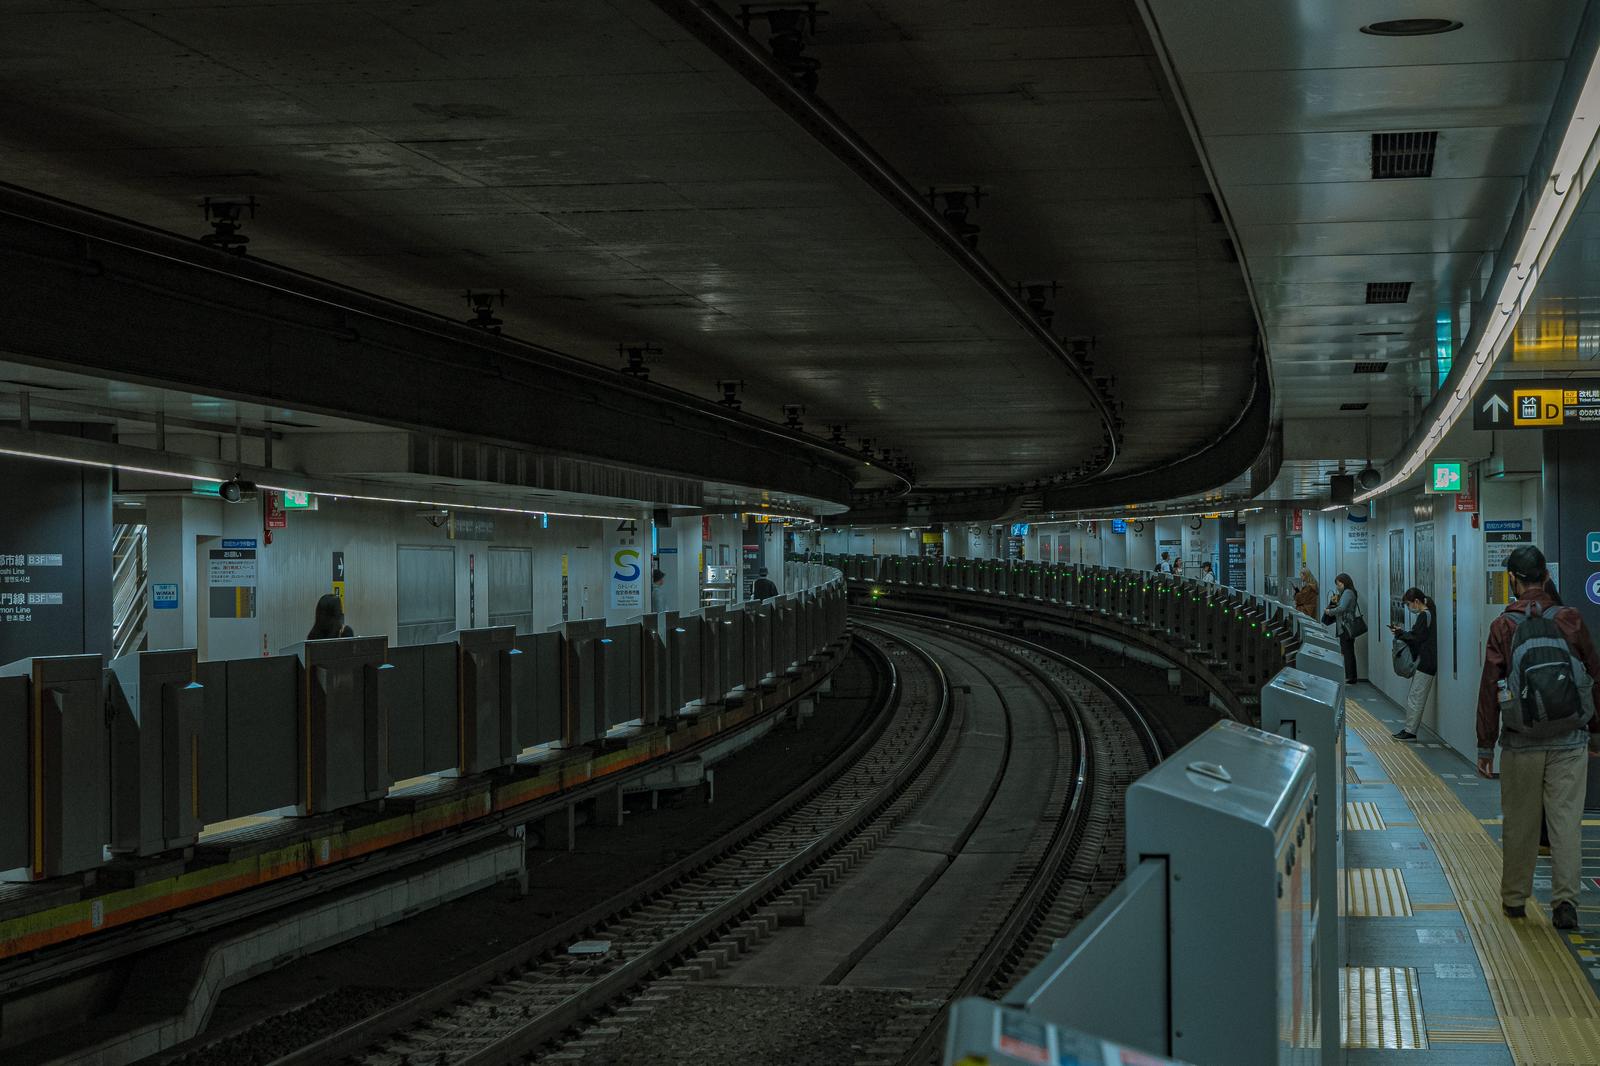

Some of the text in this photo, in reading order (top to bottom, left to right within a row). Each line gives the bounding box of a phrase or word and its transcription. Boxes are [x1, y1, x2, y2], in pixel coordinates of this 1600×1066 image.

[1545, 404, 1559, 419] D
[616, 519, 637, 536] 4
[614, 549, 640, 582] S
[0, 593, 25, 605] 門線
